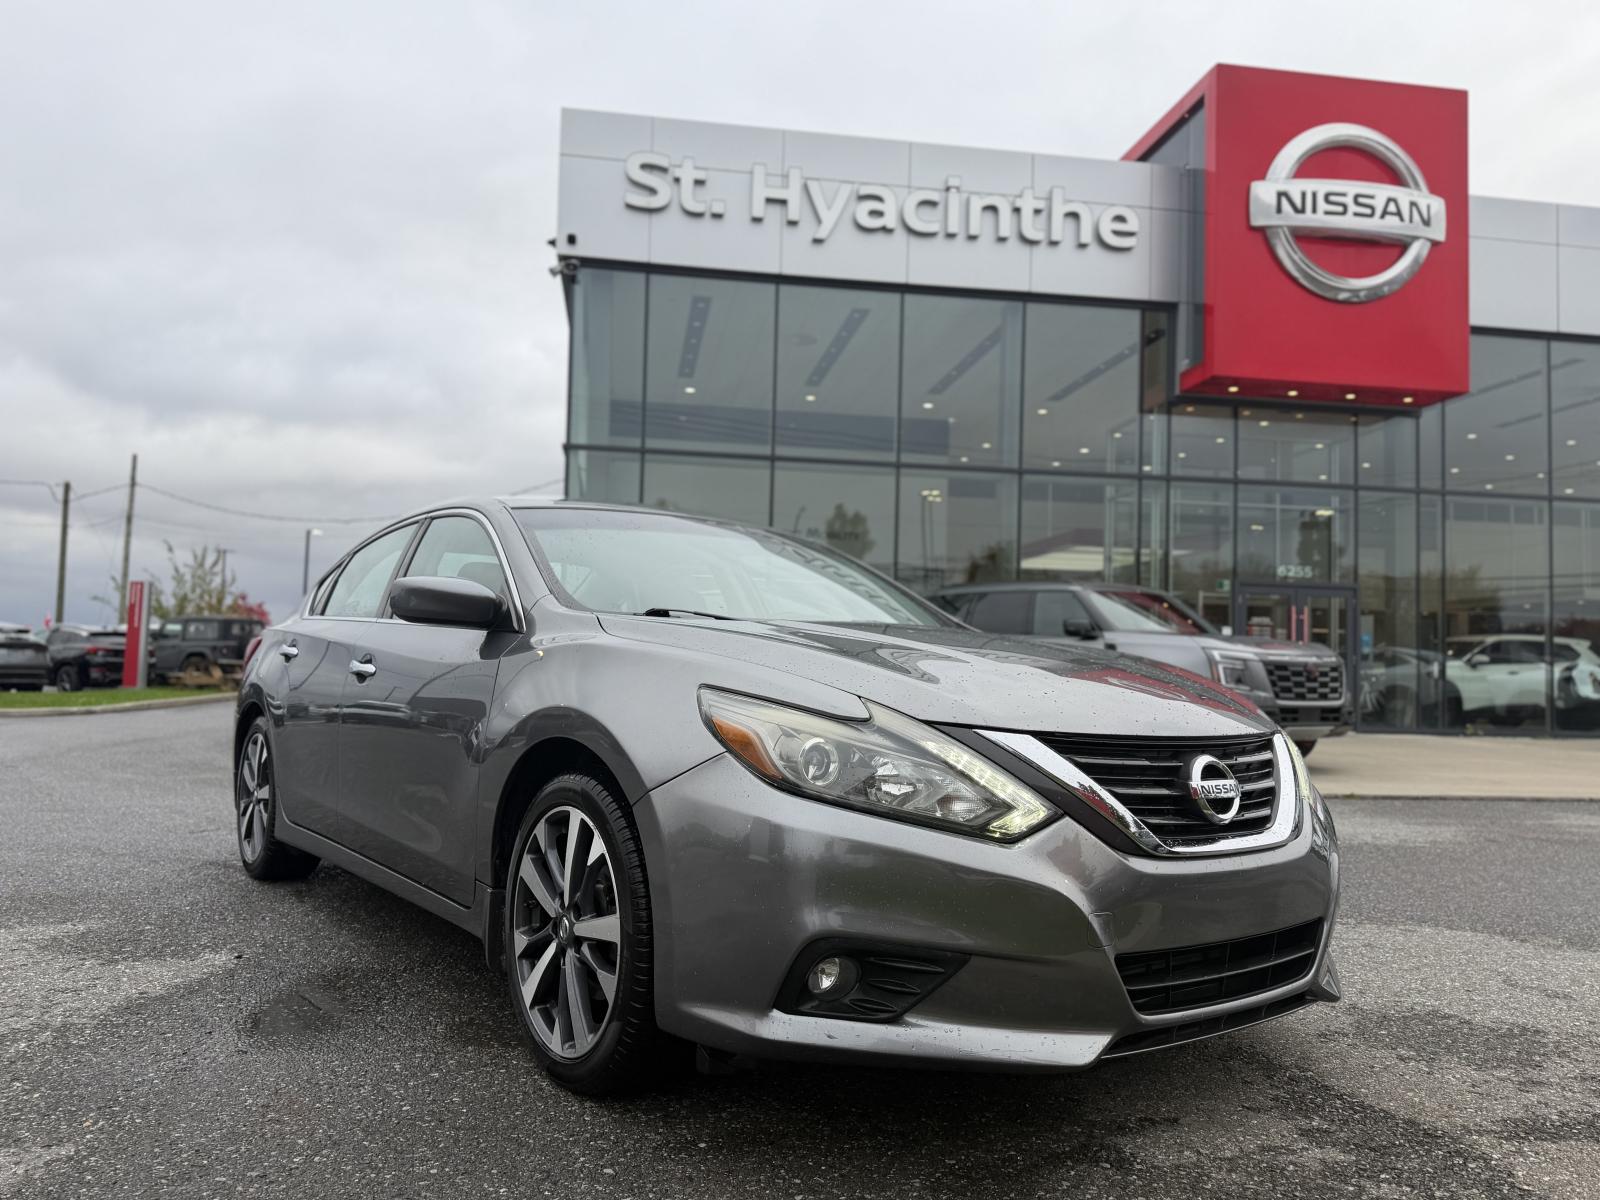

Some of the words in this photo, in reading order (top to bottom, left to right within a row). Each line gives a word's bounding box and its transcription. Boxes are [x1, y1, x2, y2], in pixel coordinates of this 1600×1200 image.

[624, 151, 726, 220] St.
[751, 163, 1139, 252] Hyacinthe
[1275, 190, 1433, 227] NISSAN
[1200, 783, 1240, 795] NISSAN
